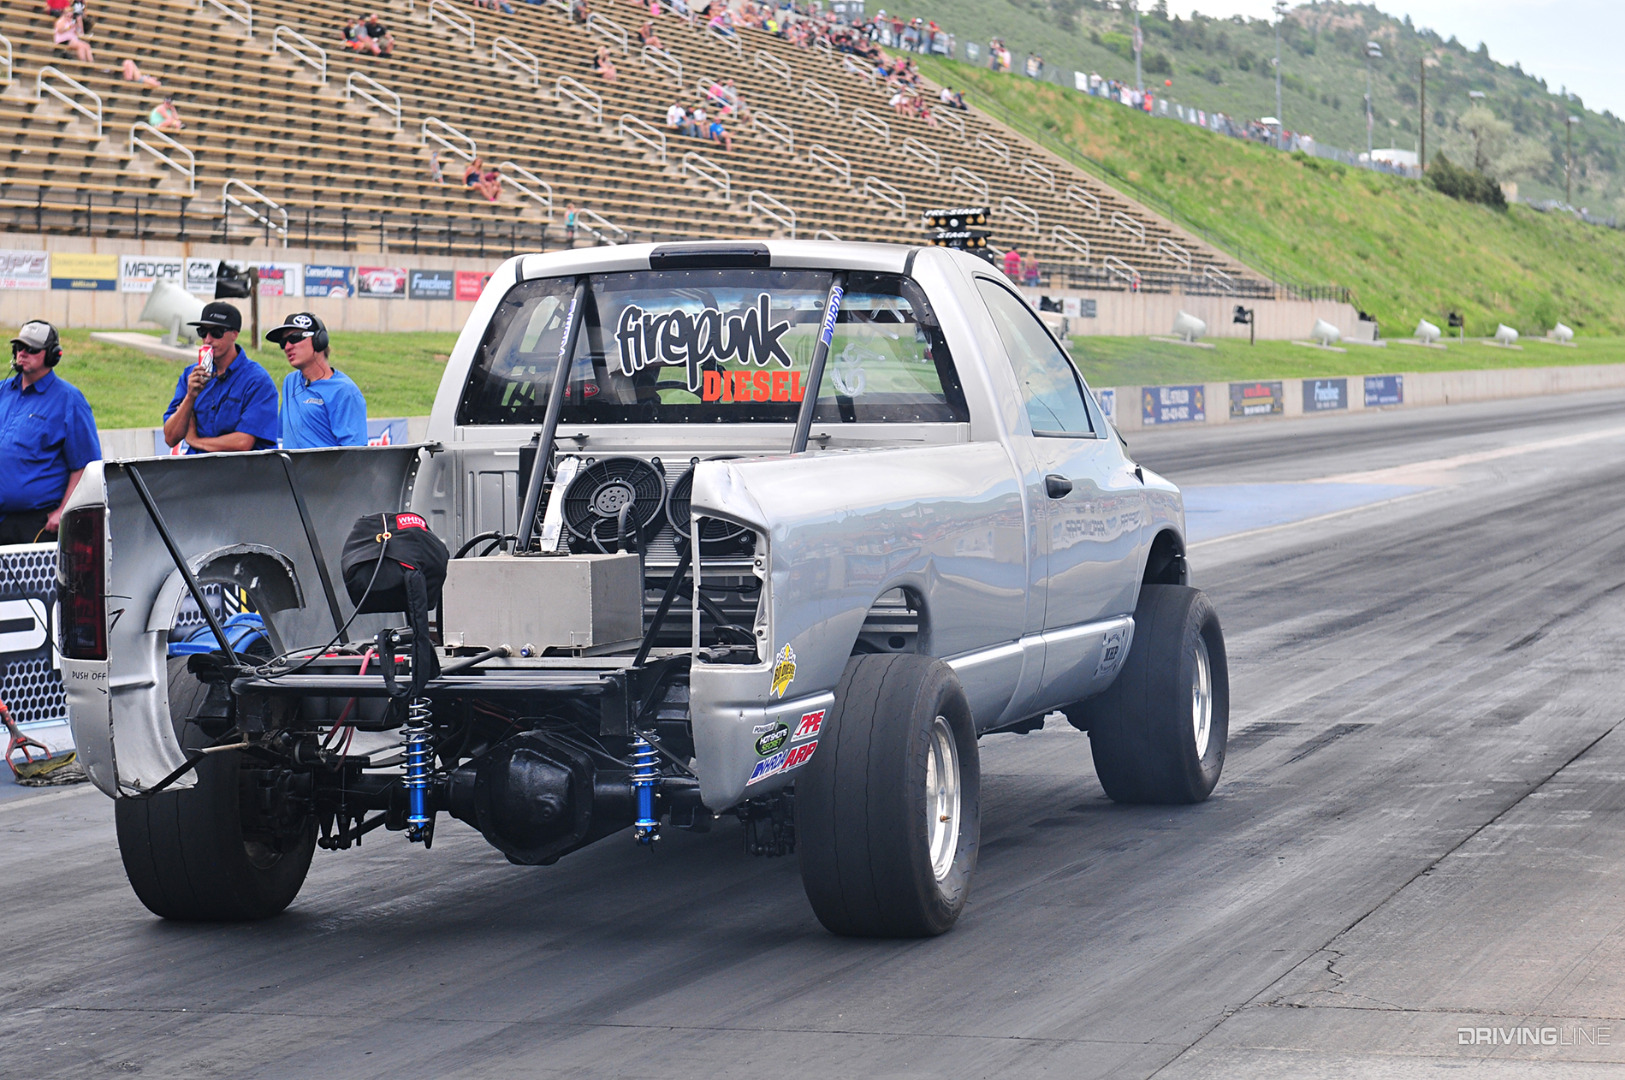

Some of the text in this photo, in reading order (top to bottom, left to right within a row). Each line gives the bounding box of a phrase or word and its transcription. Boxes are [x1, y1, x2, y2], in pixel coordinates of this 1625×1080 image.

[924, 208, 984, 217] PRE-STAGE
[936, 231, 972, 239] STAGE
[124, 261, 182, 278] MADCAP
[614, 292, 793, 391] firepunk
[702, 370, 806, 402] DIESEL
[72, 671, 107, 681] PUSH OFF
[796, 711, 825, 736] PPE
[781, 741, 818, 770] ARP
